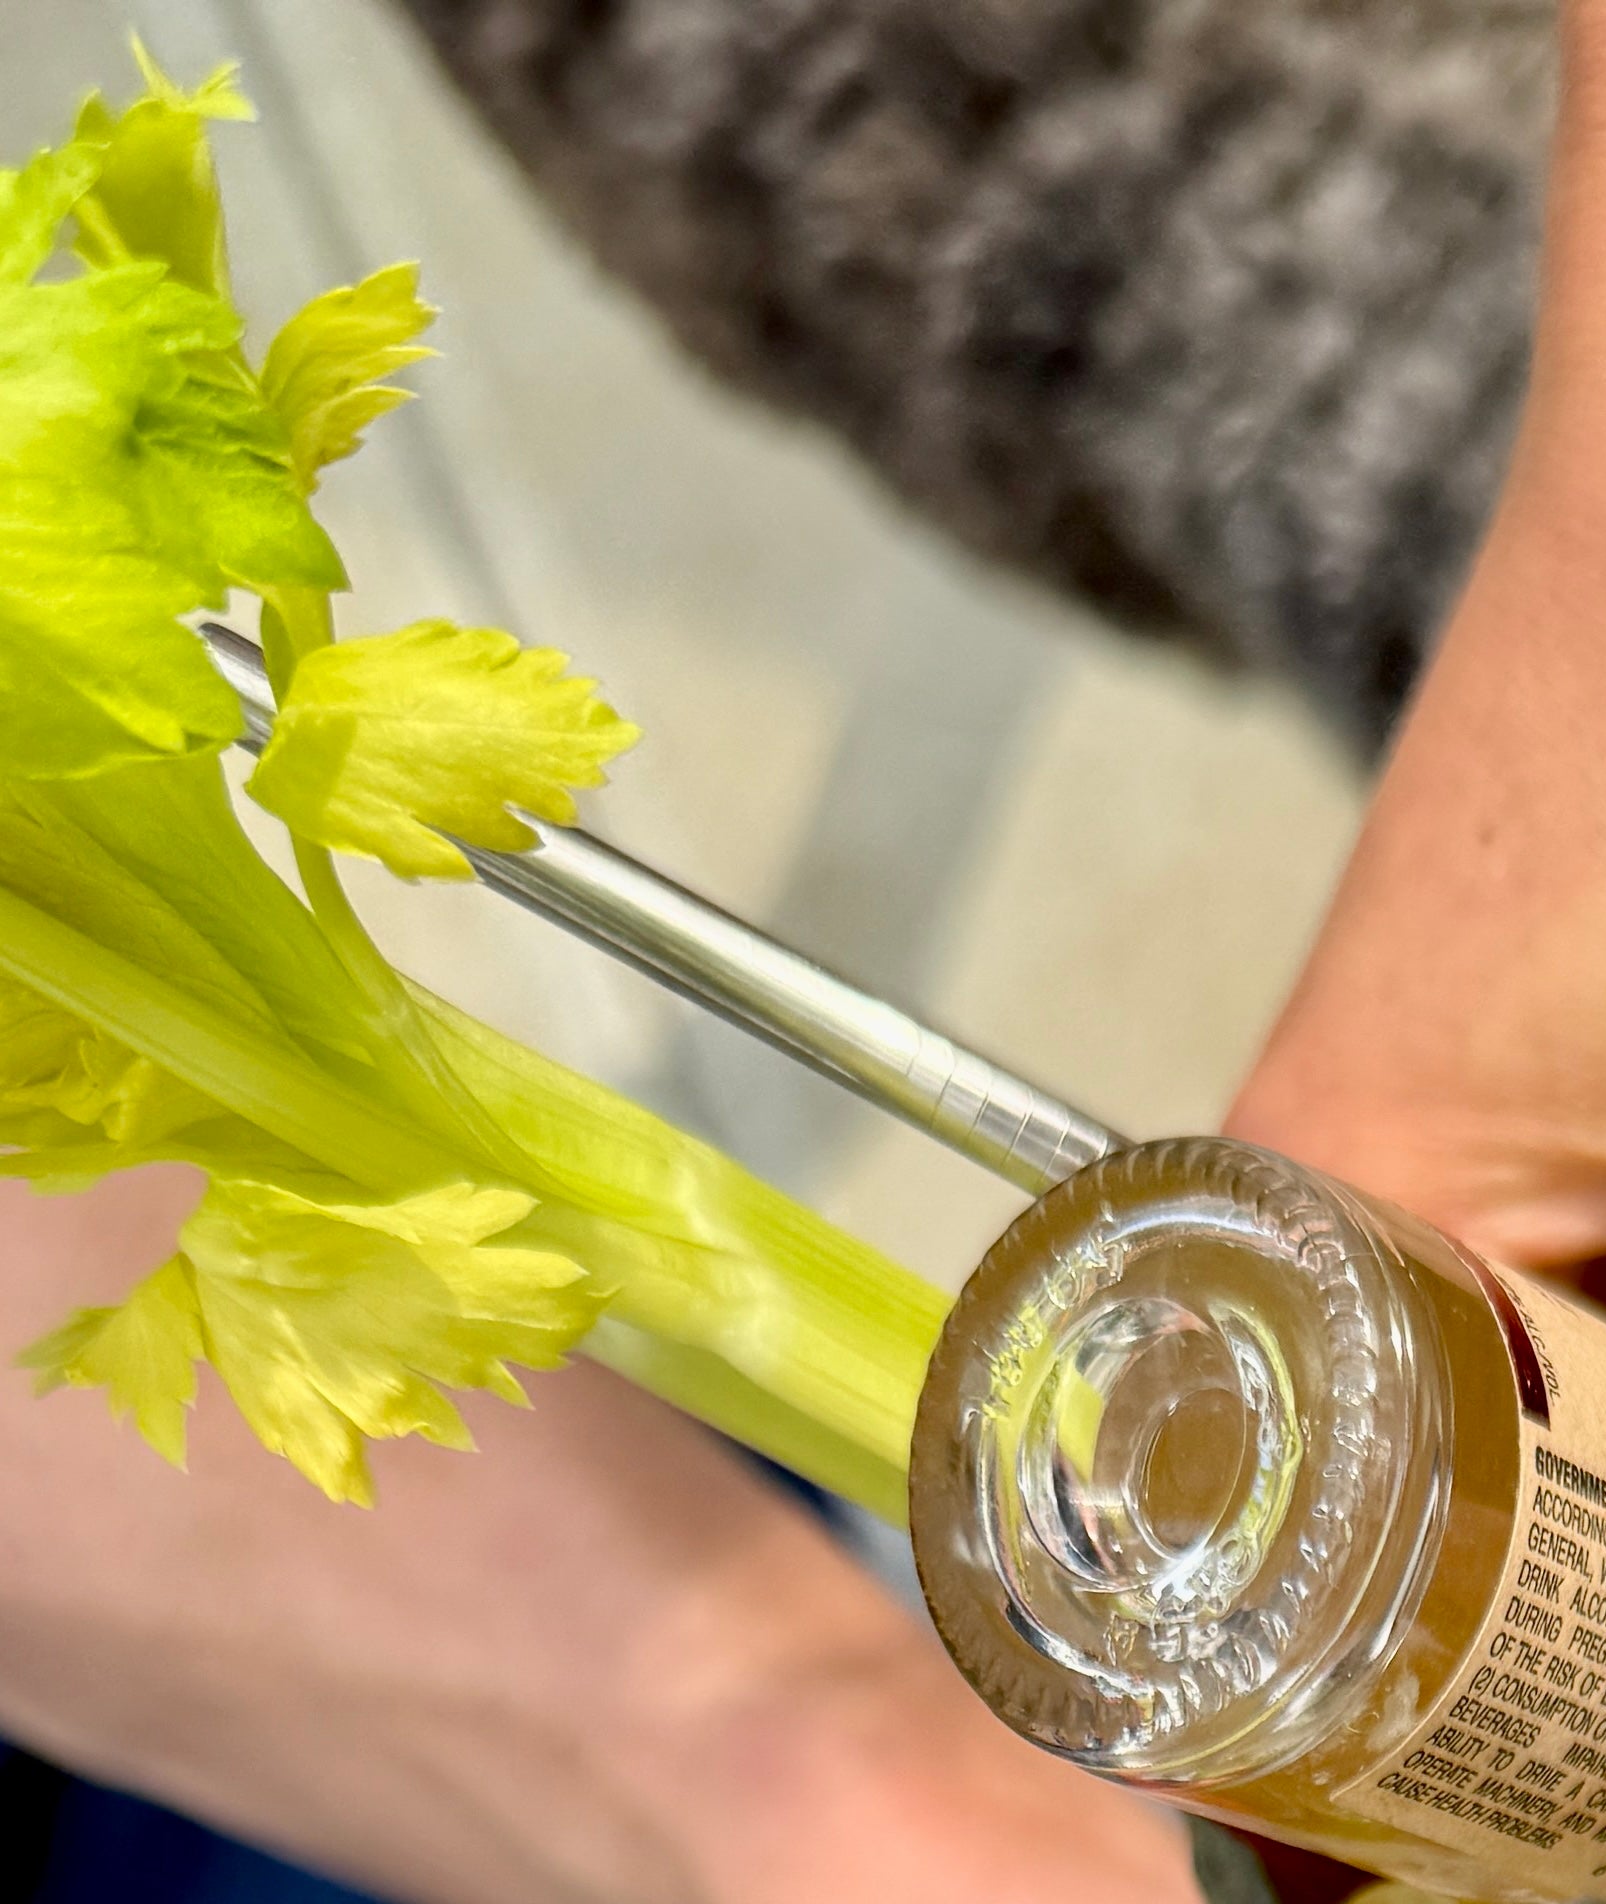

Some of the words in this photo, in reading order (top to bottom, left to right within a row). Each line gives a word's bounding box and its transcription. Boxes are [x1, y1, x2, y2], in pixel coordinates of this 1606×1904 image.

[1517, 1559, 1565, 1605] DRINK
[1527, 1521, 1594, 1584] GENERAL,
[1503, 1595, 1564, 1643] DURING
[1489, 1631, 1517, 1658] OF
[1512, 1640, 1544, 1676] THE
[1542, 1654, 1583, 1692] RISK
[1579, 1671, 1603, 1701] OF
[1447, 1694, 1542, 1749] BEVERAGES
[1468, 1664, 1497, 1698] (2)
[1492, 1673, 1596, 1737] CONSUMPTION
[1403, 1750, 1479, 1790] OPERATE
[1561, 1810, 1598, 1836] AND
[1425, 1724, 1491, 1762] ABILITY
[1488, 1748, 1515, 1773] TO
[1515, 1759, 1569, 1794] DRIVE
[1565, 1779, 1586, 1801] A
[1376, 1771, 1433, 1802] CAUSE
[1431, 1788, 1493, 1825] HEALTH
